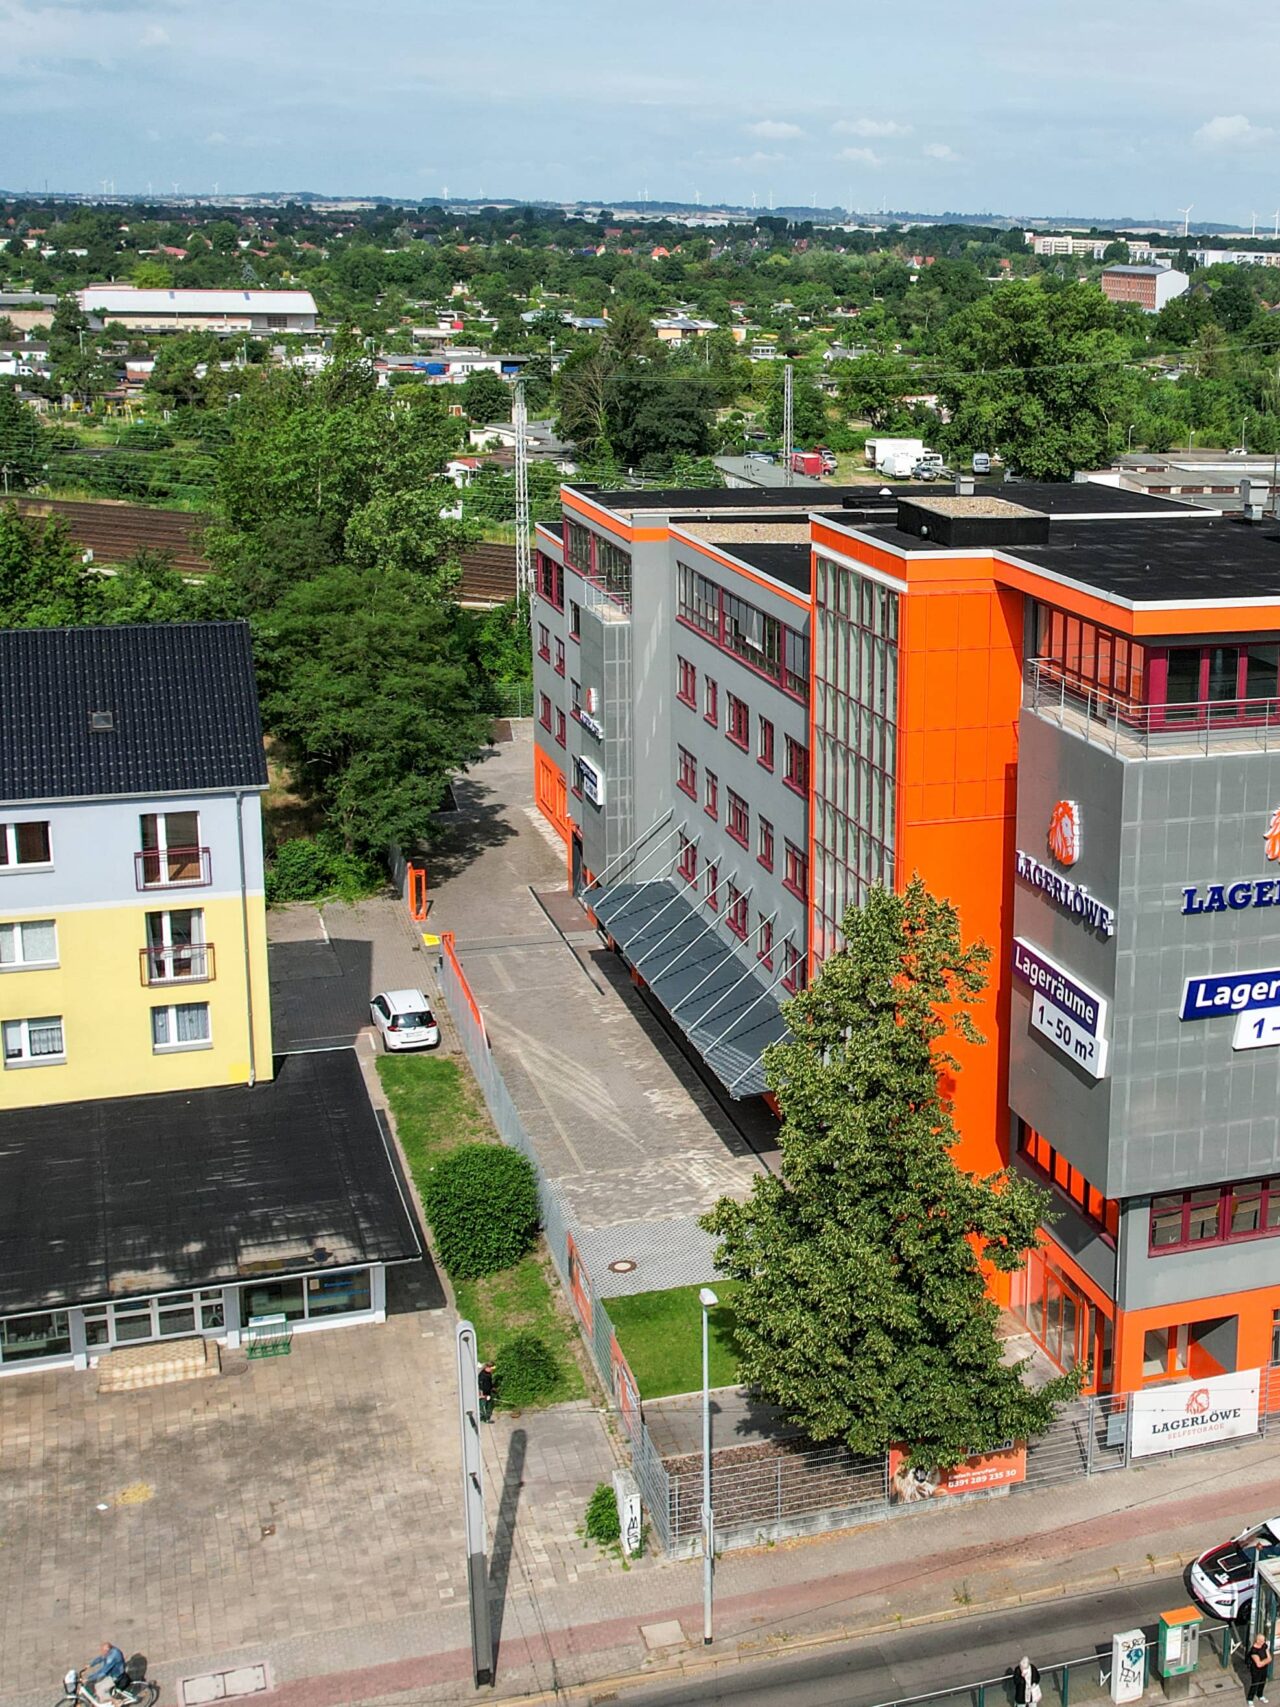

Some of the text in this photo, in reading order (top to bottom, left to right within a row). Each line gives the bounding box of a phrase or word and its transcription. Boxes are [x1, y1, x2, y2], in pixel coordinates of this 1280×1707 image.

[1016, 850, 1114, 936] LAGERLÖWE
[1015, 946, 1094, 1025] Lagerräume
[1038, 1005, 1045, 1024] 1
[1055, 1018, 1072, 1046] 50
[1252, 1017, 1265, 1039] 1
[1152, 1408, 1241, 1434] LAGERLÖWE
